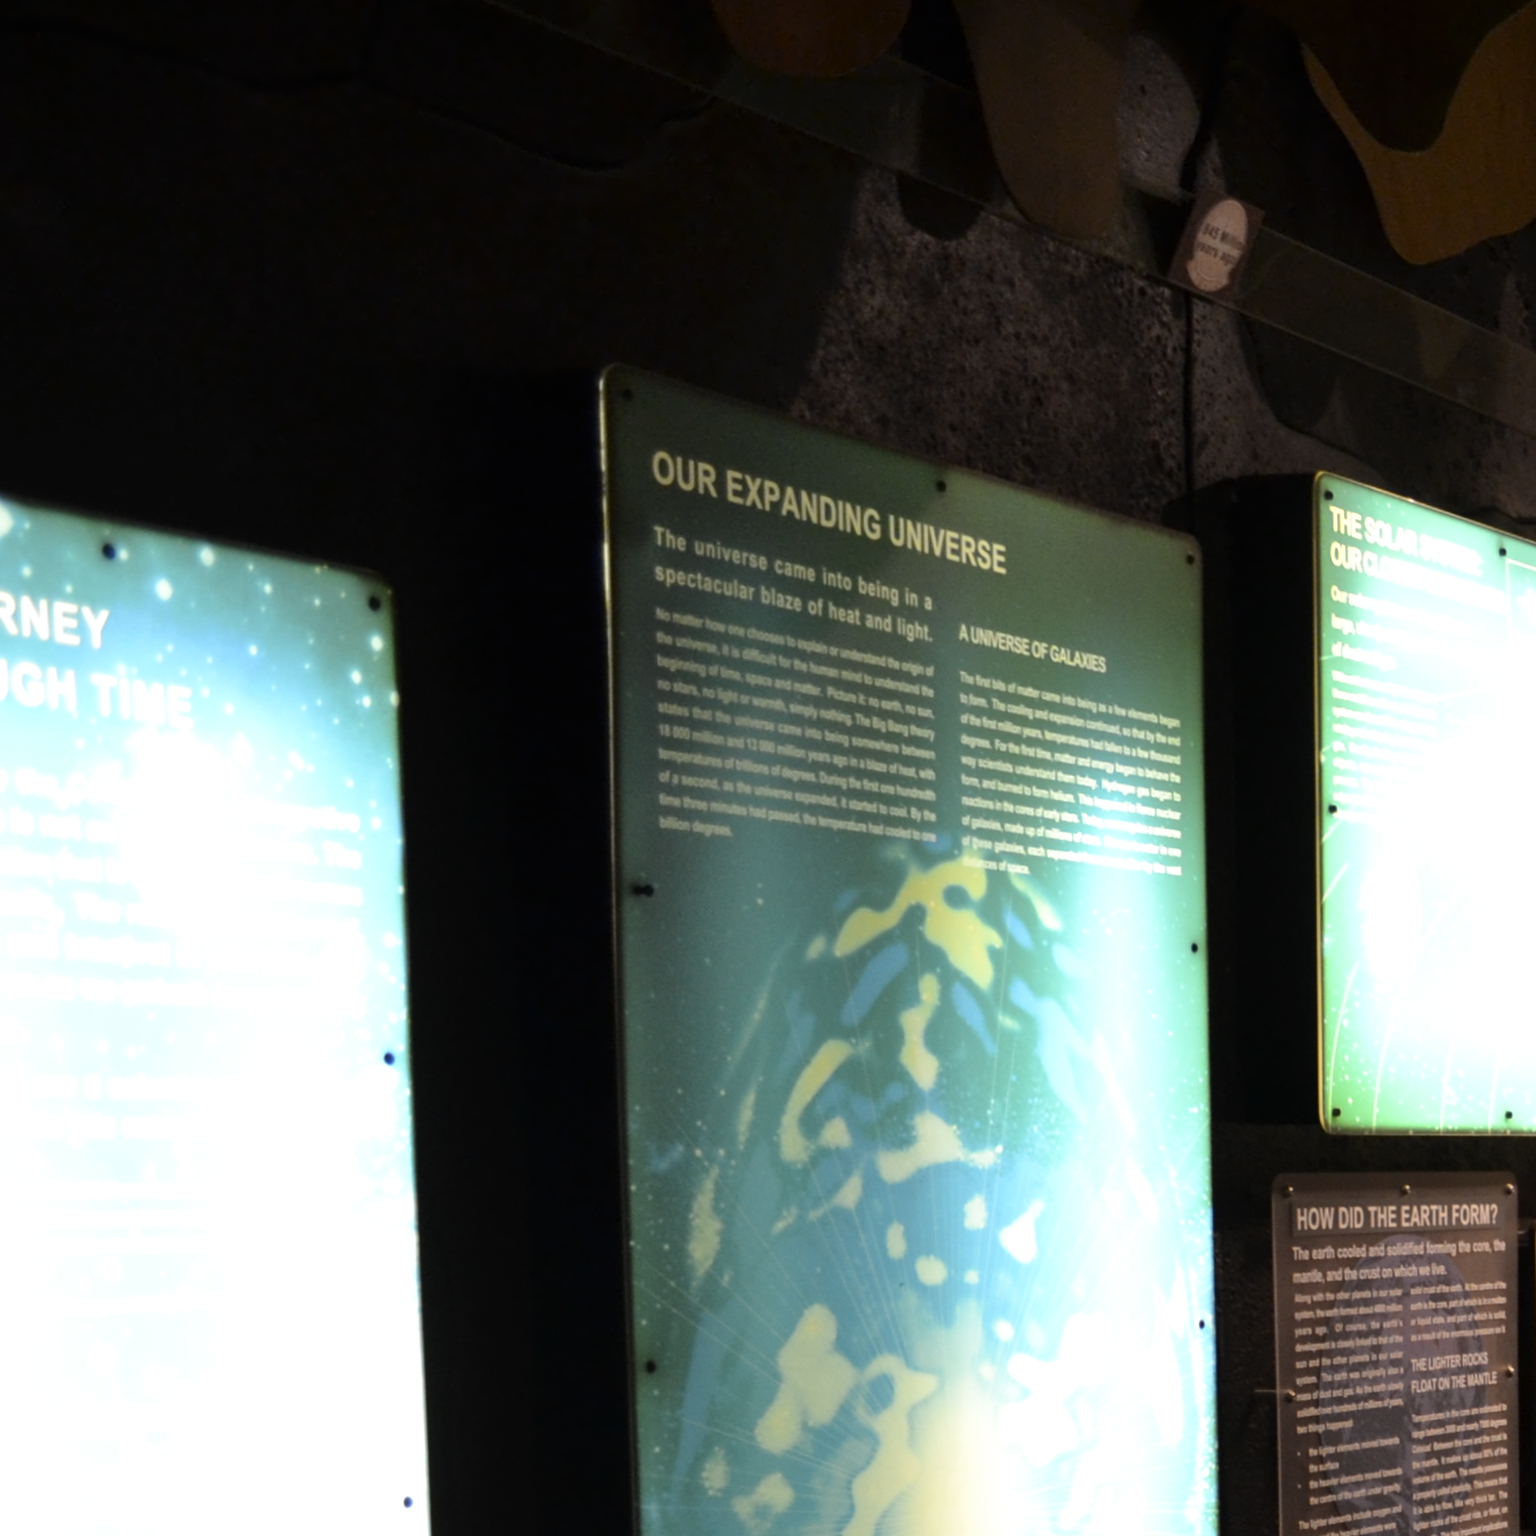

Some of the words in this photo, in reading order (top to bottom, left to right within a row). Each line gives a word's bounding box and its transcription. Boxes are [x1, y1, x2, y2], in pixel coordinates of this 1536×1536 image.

[652, 450, 717, 499] OUR
[727, 470, 881, 542] EXPANDING
[889, 513, 1007, 575] UNIVERSE
[1330, 505, 1362, 540] THE
[654, 526, 687, 552] The
[695, 540, 768, 571] universe
[775, 560, 816, 583] came
[822, 568, 852, 591] into
[858, 576, 899, 606] being
[905, 588, 918, 607] in
[924, 597, 933, 610] a
[1330, 541, 1362, 573] OUR
[655, 565, 754, 602] spectacular
[761, 586, 802, 612] blaze
[808, 597, 823, 617] of
[829, 602, 860, 625] heat
[866, 615, 892, 632] and
[898, 619, 933, 641] light.
[959, 624, 969, 642] A
[971, 626, 1029, 655] UNIVERSE
[1032, 640, 1048, 660] OF
[1050, 644, 1107, 673] GALAXIES
[1297, 1207, 1334, 1230] HOW
[1338, 1207, 1364, 1229] DID
[1368, 1206, 1397, 1228] THE
[1402, 1205, 1447, 1227] EARTH
[1452, 1204, 1498, 1225] FORM?
[1292, 1247, 1309, 1261] The
[1312, 1246, 1335, 1260] earth
[1337, 1244, 1365, 1259] cooled
[1369, 1244, 1384, 1257] and
[1387, 1242, 1424, 1256] solidified
[1426, 1241, 1456, 1256] forming
[1459, 1241, 1470, 1253] the
[1473, 1243, 1492, 1253] core,
[1494, 1239, 1506, 1251] the
[1411, 1358, 1427, 1371] THE
[1429, 1355, 1460, 1370] LIGHTER
[1463, 1353, 1488, 1366] ROCKS
[1411, 1378, 1436, 1393] FLOAT
[1438, 1376, 1449, 1390] ON
[1451, 1375, 1466, 1389] THE
[1468, 1372, 1497, 1387] MANTLE
